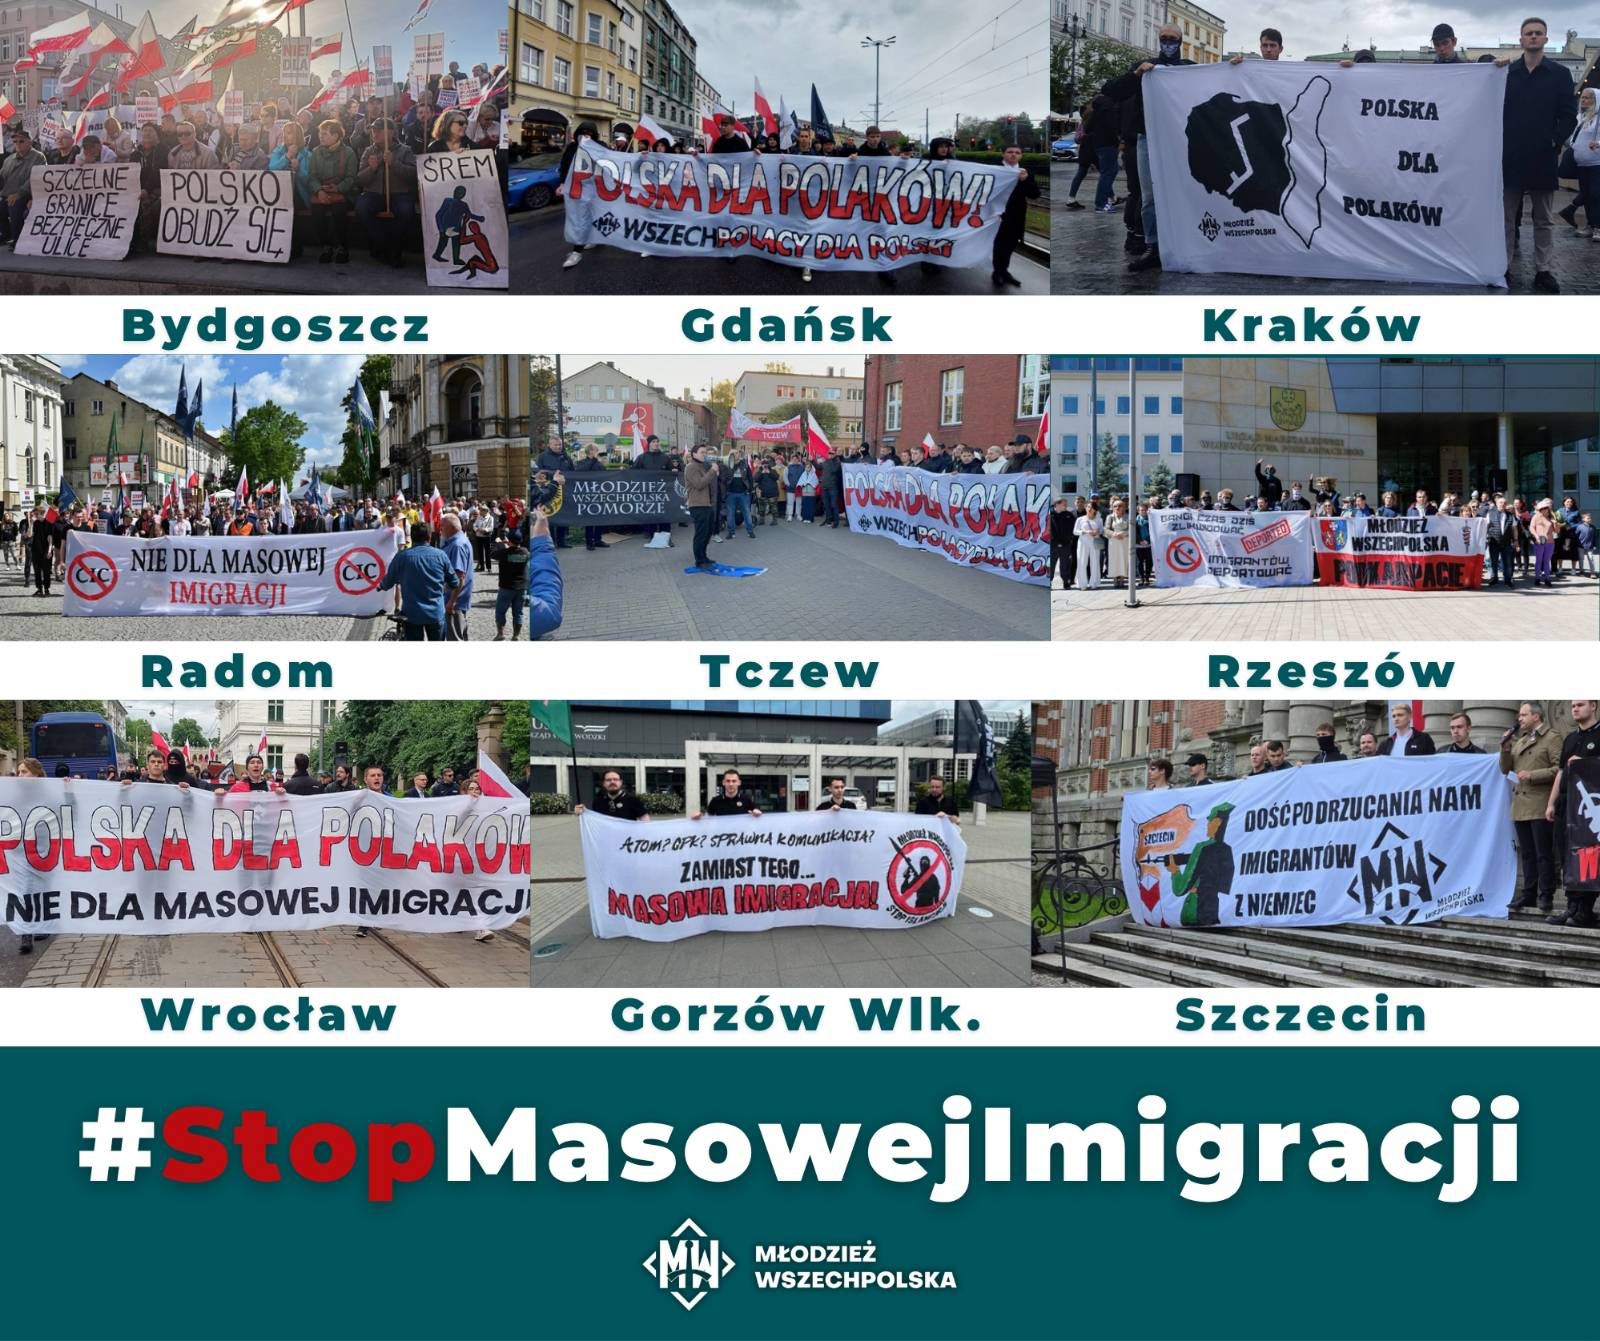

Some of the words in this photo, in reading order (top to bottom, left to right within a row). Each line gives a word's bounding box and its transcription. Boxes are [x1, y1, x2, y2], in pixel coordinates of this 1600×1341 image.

[1360, 98, 1440, 121] POLSKA
[1397, 150, 1439, 174] DLA
[42, 167, 129, 192] SZCZELNE
[170, 171, 280, 206] POLSKO
[569, 148, 702, 212] POLSKA
[707, 162, 772, 215] DLA
[779, 160, 995, 229] POLAKÓW!
[46, 192, 119, 217] GRANICE
[1343, 195, 1444, 227] POLAKÓW
[30, 215, 127, 239] BEZPIECZNE
[246, 206, 289, 258] SIĘ
[41, 236, 92, 257] ULICE
[814, 233, 864, 260] DLA
[574, 414, 613, 425] gamma
[762, 431, 789, 440] TCZEW
[572, 493, 671, 503] WSZECHPOLSKA
[573, 479, 667, 494] MŁODZIEŻ
[577, 502, 666, 516] POMORZE
[1244, 522, 1288, 551] DEPORTED
[1367, 516, 1429, 534] MŁODZIEŻ
[1352, 535, 1450, 552] WSZECHPOLSKA
[130, 548, 168, 573] NIE
[173, 548, 217, 574] DLA
[222, 547, 328, 576] MASOWEJ
[169, 581, 288, 609] IMIGRACJI
[1428, 784, 1482, 812] NAM
[0, 804, 195, 875] POLSKA
[211, 807, 302, 871] DLA
[710, 832, 772, 848] SPRAWNA
[1144, 831, 1176, 846] SZCZECIN
[679, 857, 756, 884] ZAMIAST
[758, 856, 816, 880] TEGO...
[1239, 841, 1357, 875] IMIGRANTÓW
[5, 891, 61, 923] NIE
[70, 890, 144, 921] DLA
[154, 886, 340, 920] MASOWEJ
[608, 886, 728, 926] MASOWA
[734, 877, 880, 915] IMIGRACJA!
[1234, 894, 1244, 917] Z
[1247, 890, 1317, 917] NIEMIEC
